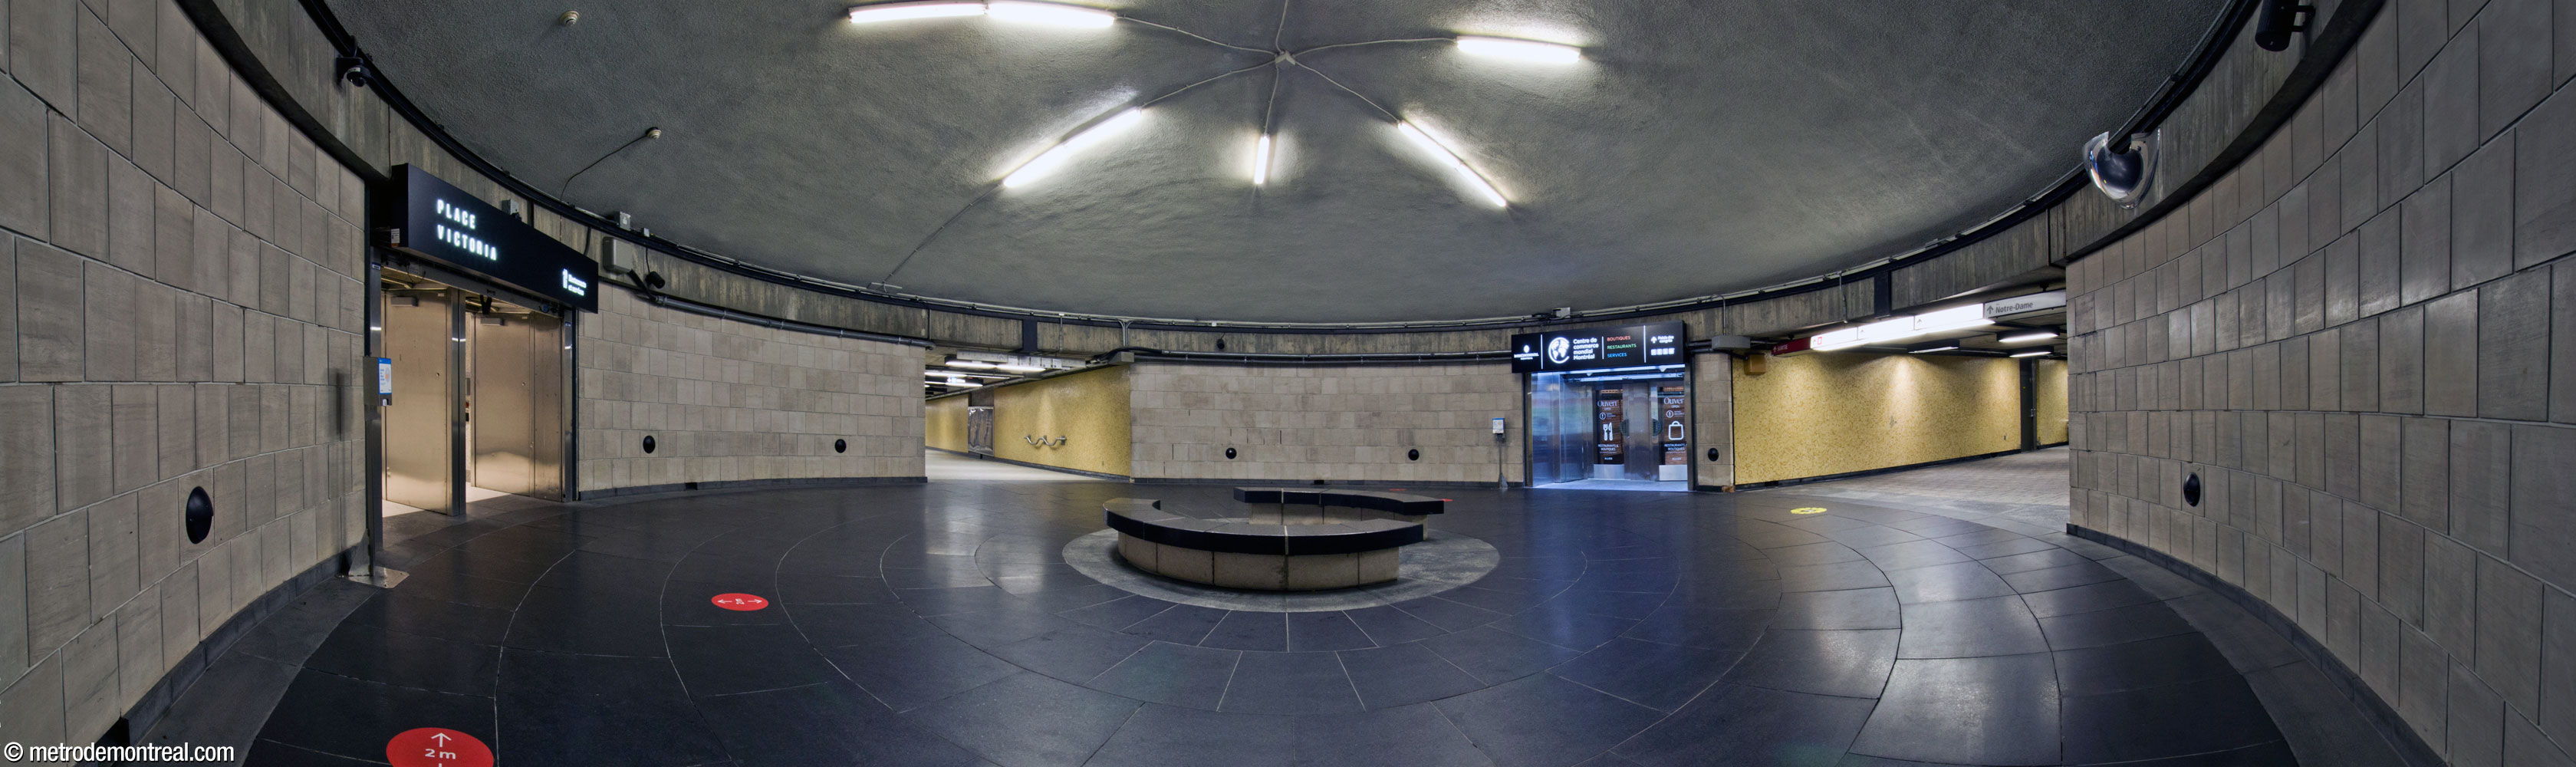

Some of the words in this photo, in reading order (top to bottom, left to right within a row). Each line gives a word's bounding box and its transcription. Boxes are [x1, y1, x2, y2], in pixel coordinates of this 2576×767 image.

[436, 199, 475, 229] PLACE
[436, 224, 497, 261] VICTORIA
[1995, 302, 2033, 313] Notre-Dame
[425, 748, 436, 758] 2
[439, 751, 456, 759] m
